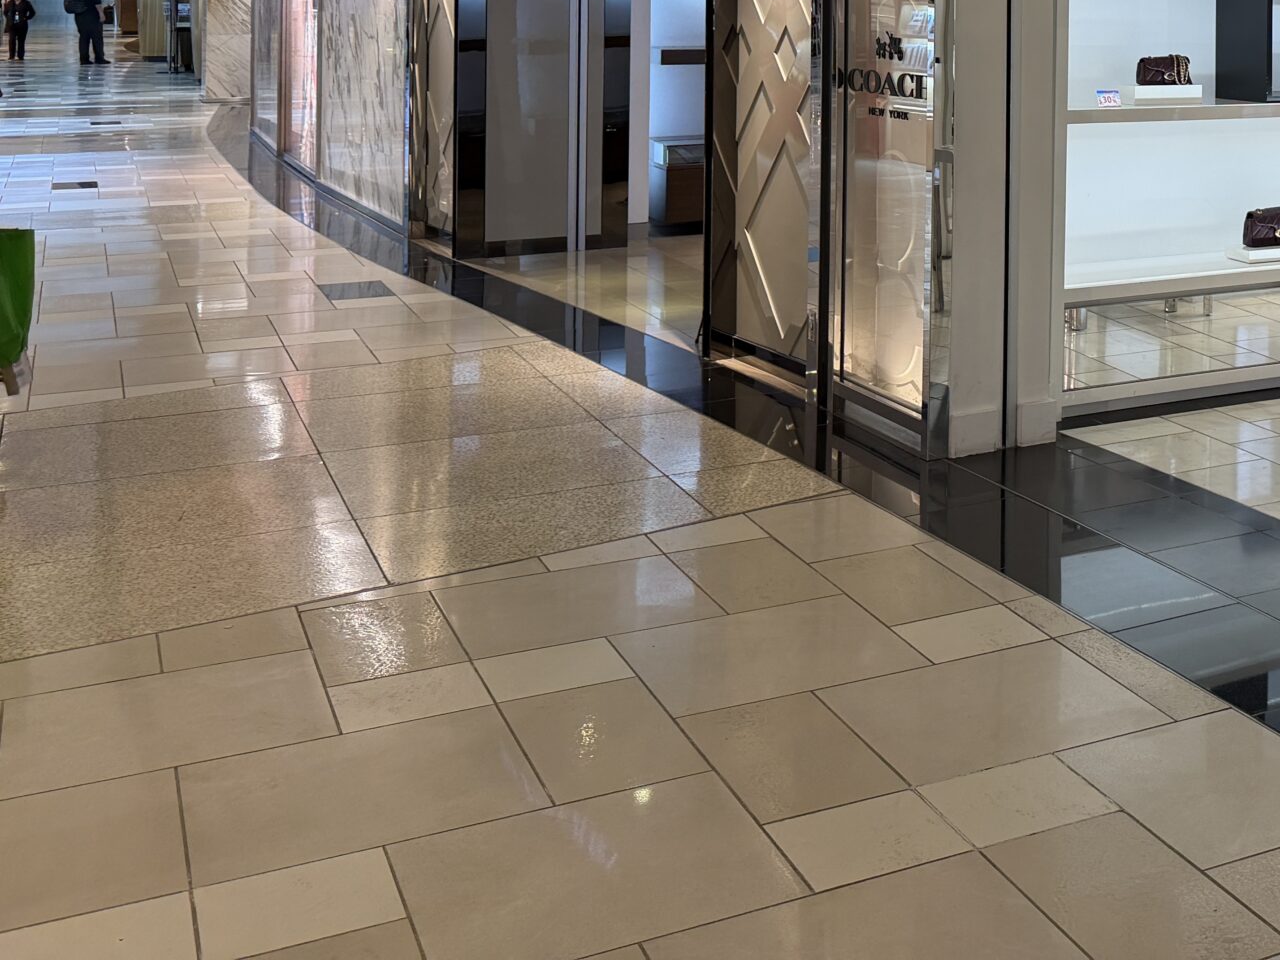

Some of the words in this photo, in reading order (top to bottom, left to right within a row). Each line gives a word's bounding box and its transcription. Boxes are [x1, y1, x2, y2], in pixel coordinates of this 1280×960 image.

[848, 68, 928, 100] COACH
[868, 107, 885, 117] NEW
[889, 109, 909, 121] YORK
